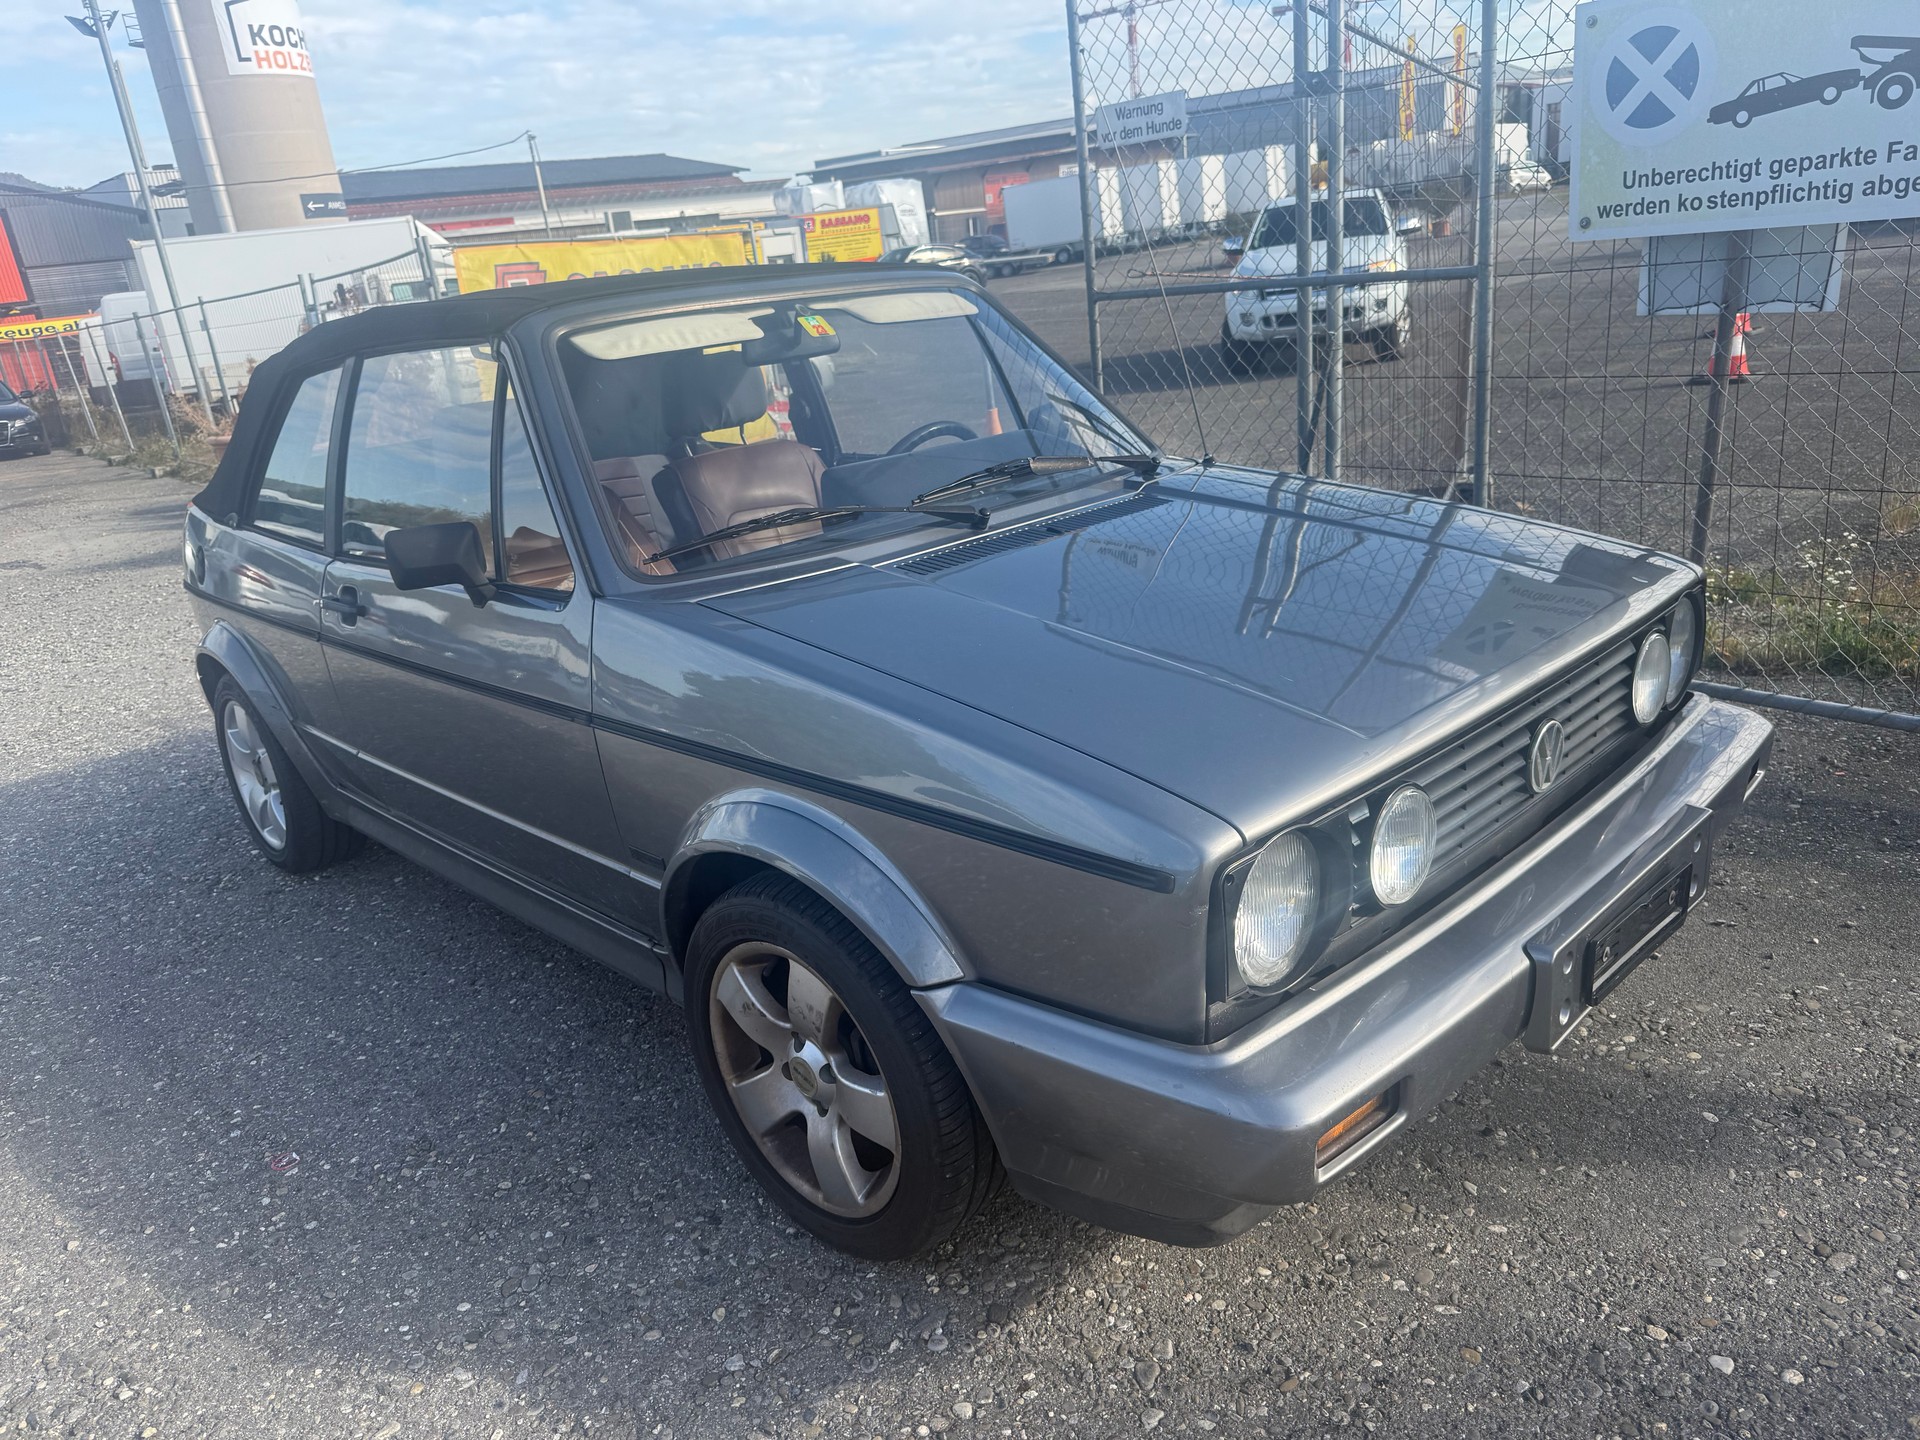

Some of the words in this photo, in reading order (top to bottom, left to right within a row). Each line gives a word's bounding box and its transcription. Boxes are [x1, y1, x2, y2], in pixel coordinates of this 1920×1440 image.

[247, 24, 308, 50] KOCH
[1115, 102, 1164, 121] Warnung
[1101, 131, 1117, 143] vor
[1120, 126, 1143, 140] dem
[1146, 117, 1182, 135] Hunde
[1622, 156, 1762, 190] Unberechtigt
[1768, 146, 1877, 180] geparkte
[1597, 197, 1670, 219] werden
